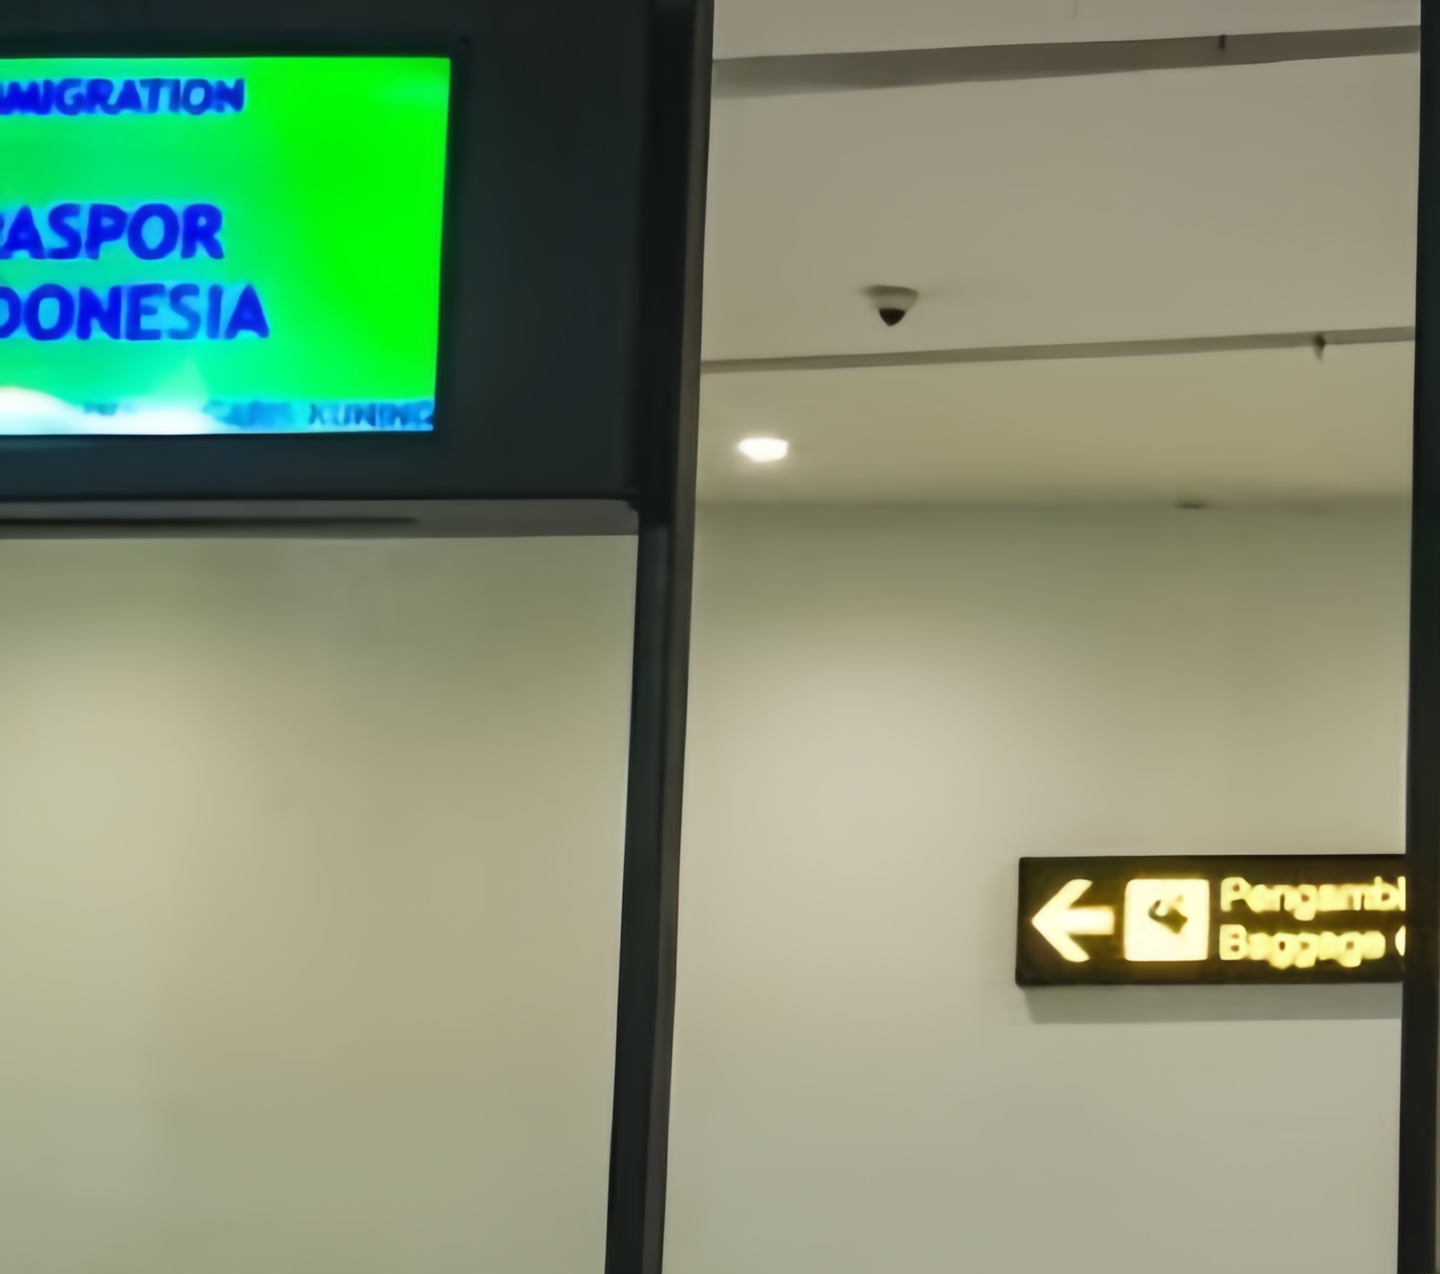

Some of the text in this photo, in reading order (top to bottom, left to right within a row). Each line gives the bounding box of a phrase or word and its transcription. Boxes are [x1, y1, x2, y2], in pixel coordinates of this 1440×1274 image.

[0, 78, 244, 116] MIGRATION
[0, 202, 224, 260] ASPOR
[1219, 924, 1386, 969] Baggage
